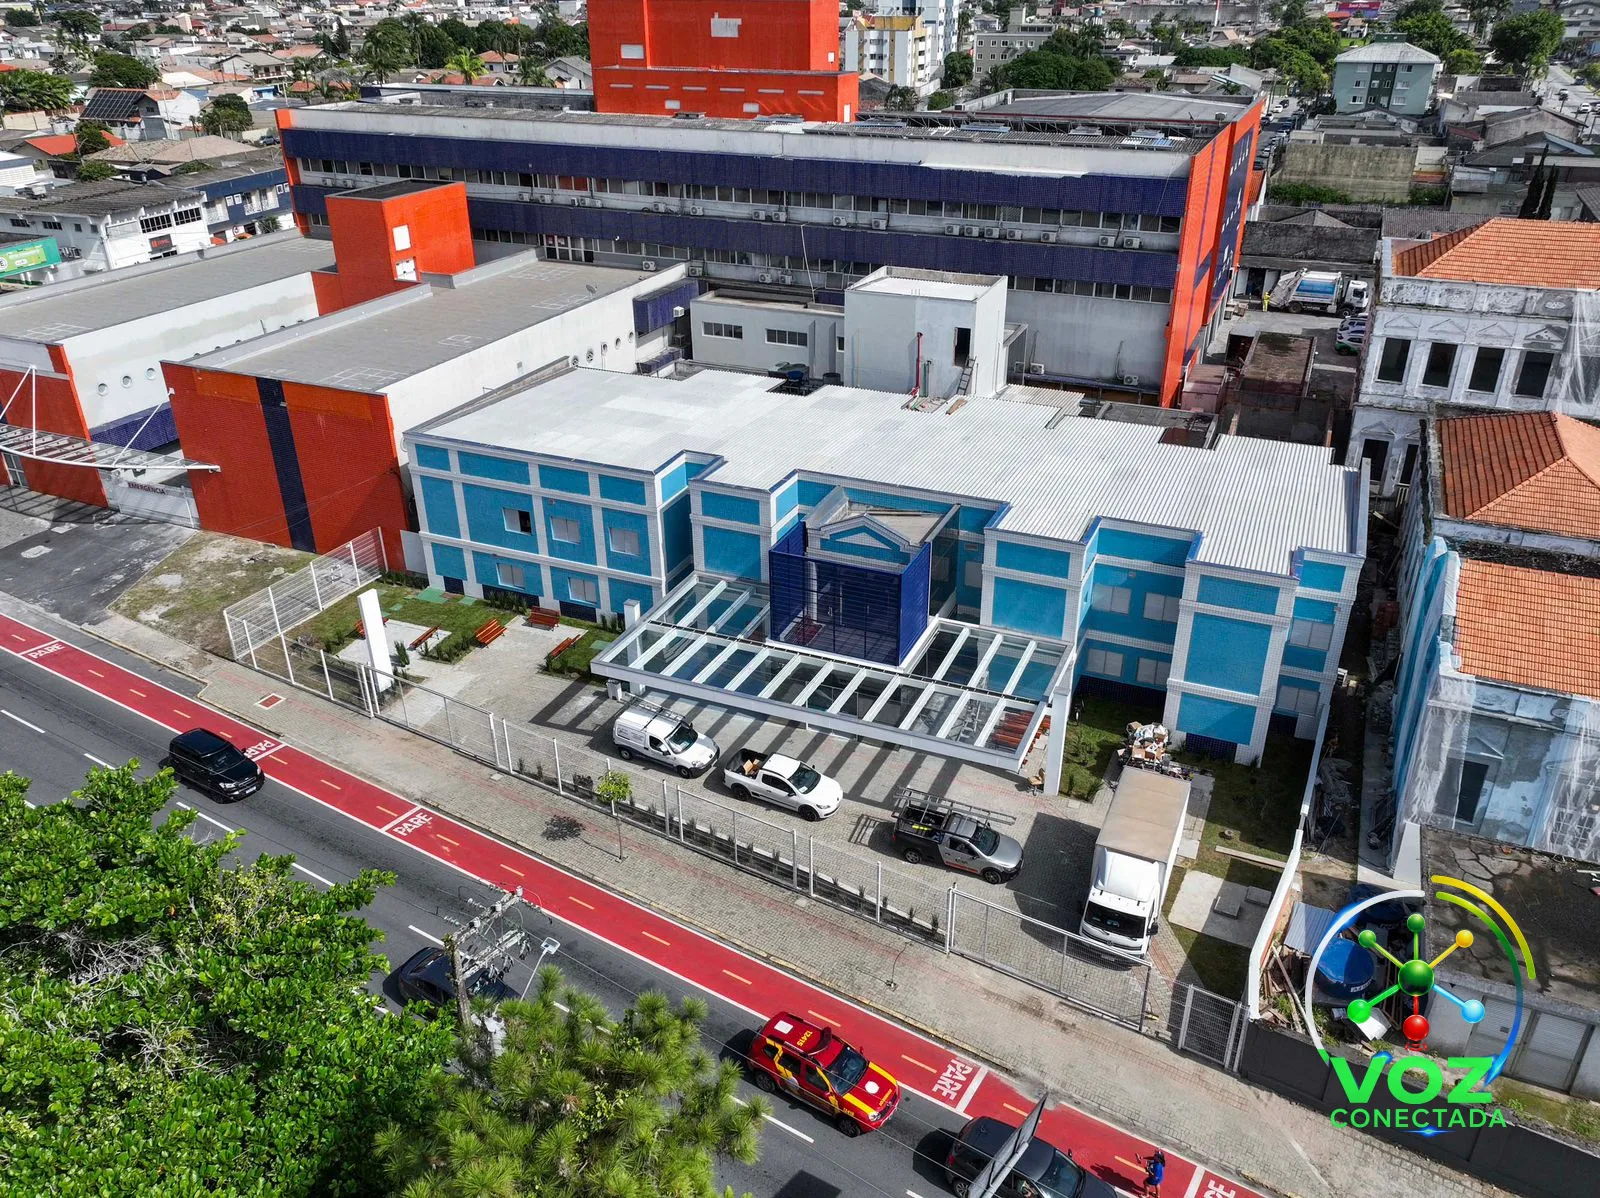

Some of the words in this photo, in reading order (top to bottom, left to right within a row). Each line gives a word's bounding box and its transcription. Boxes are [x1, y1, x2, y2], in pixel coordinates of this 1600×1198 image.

[28, 643, 65, 659] PARE
[244, 740, 276, 758] PAR
[393, 812, 433, 836] PARE
[932, 1059, 974, 1101] PARE
